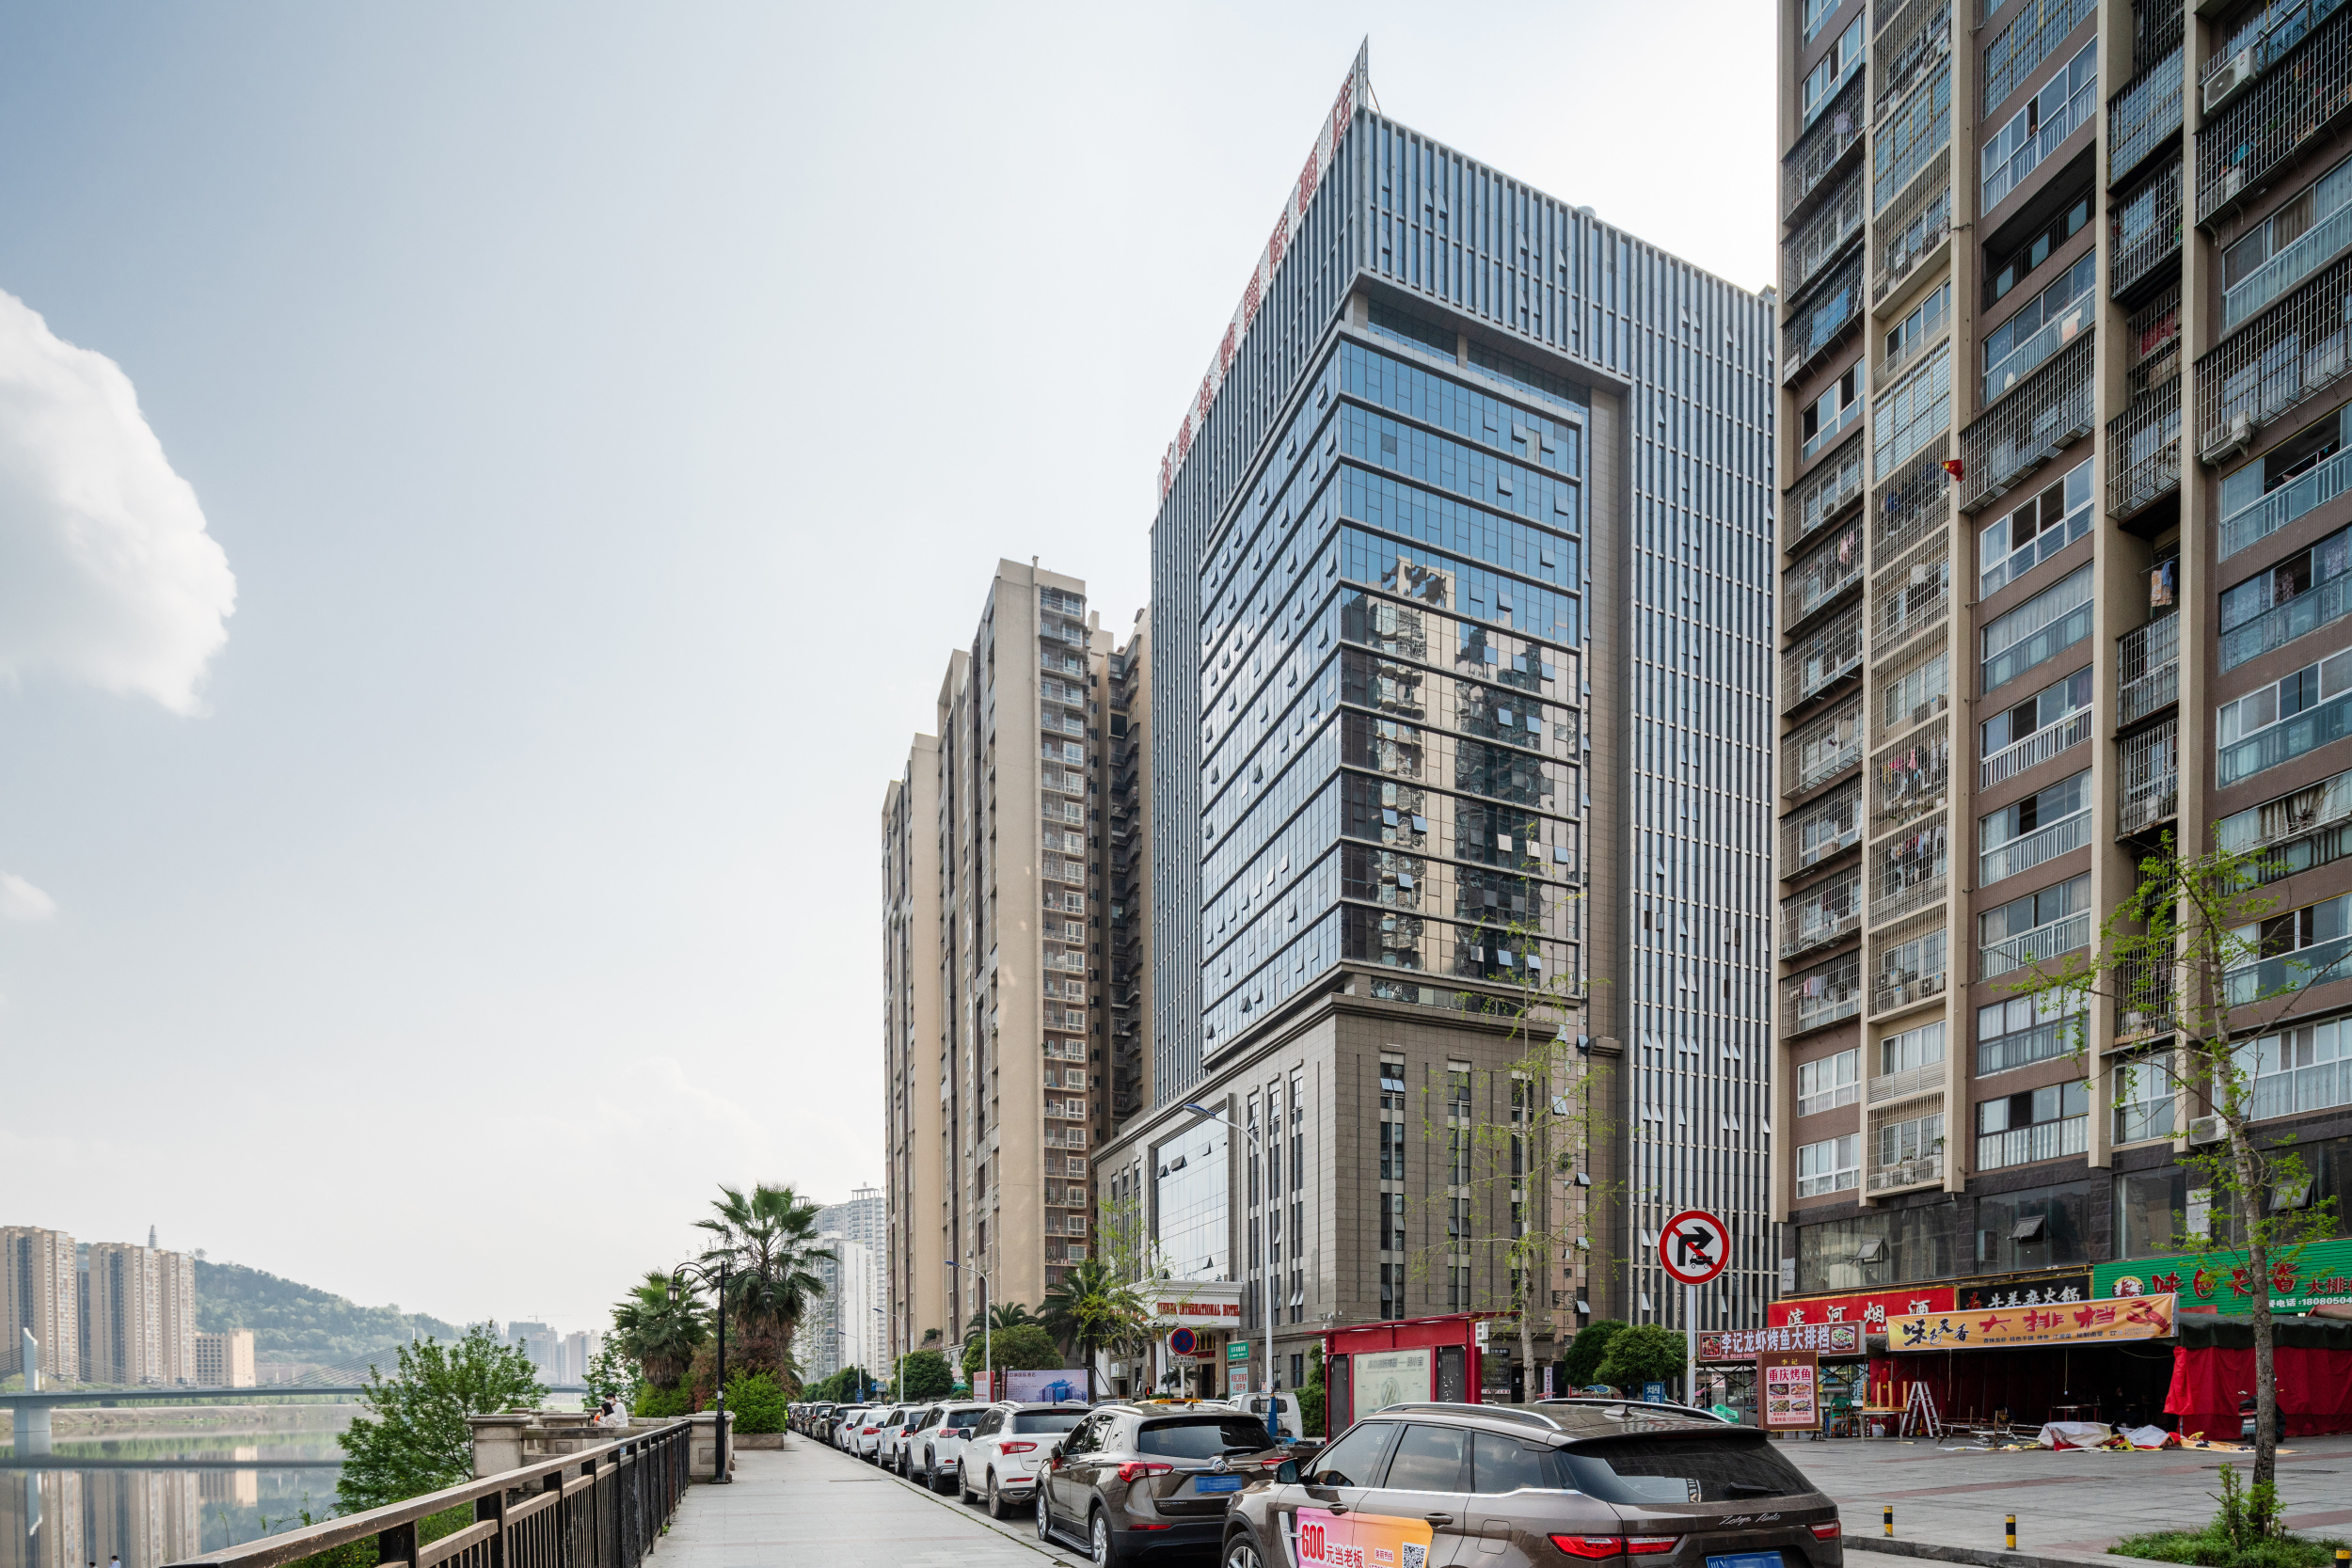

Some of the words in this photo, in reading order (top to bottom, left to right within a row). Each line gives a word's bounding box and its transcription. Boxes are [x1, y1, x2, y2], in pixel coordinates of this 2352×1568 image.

[1179, 1303, 1220, 1316] INTERNATIONAL
[1222, 1304, 1240, 1317] HOTEL
[1721, 1325, 1830, 1354] 李记龙虾烤鱼大排档
[1768, 1368, 1811, 1383] 重庆烤鱼
